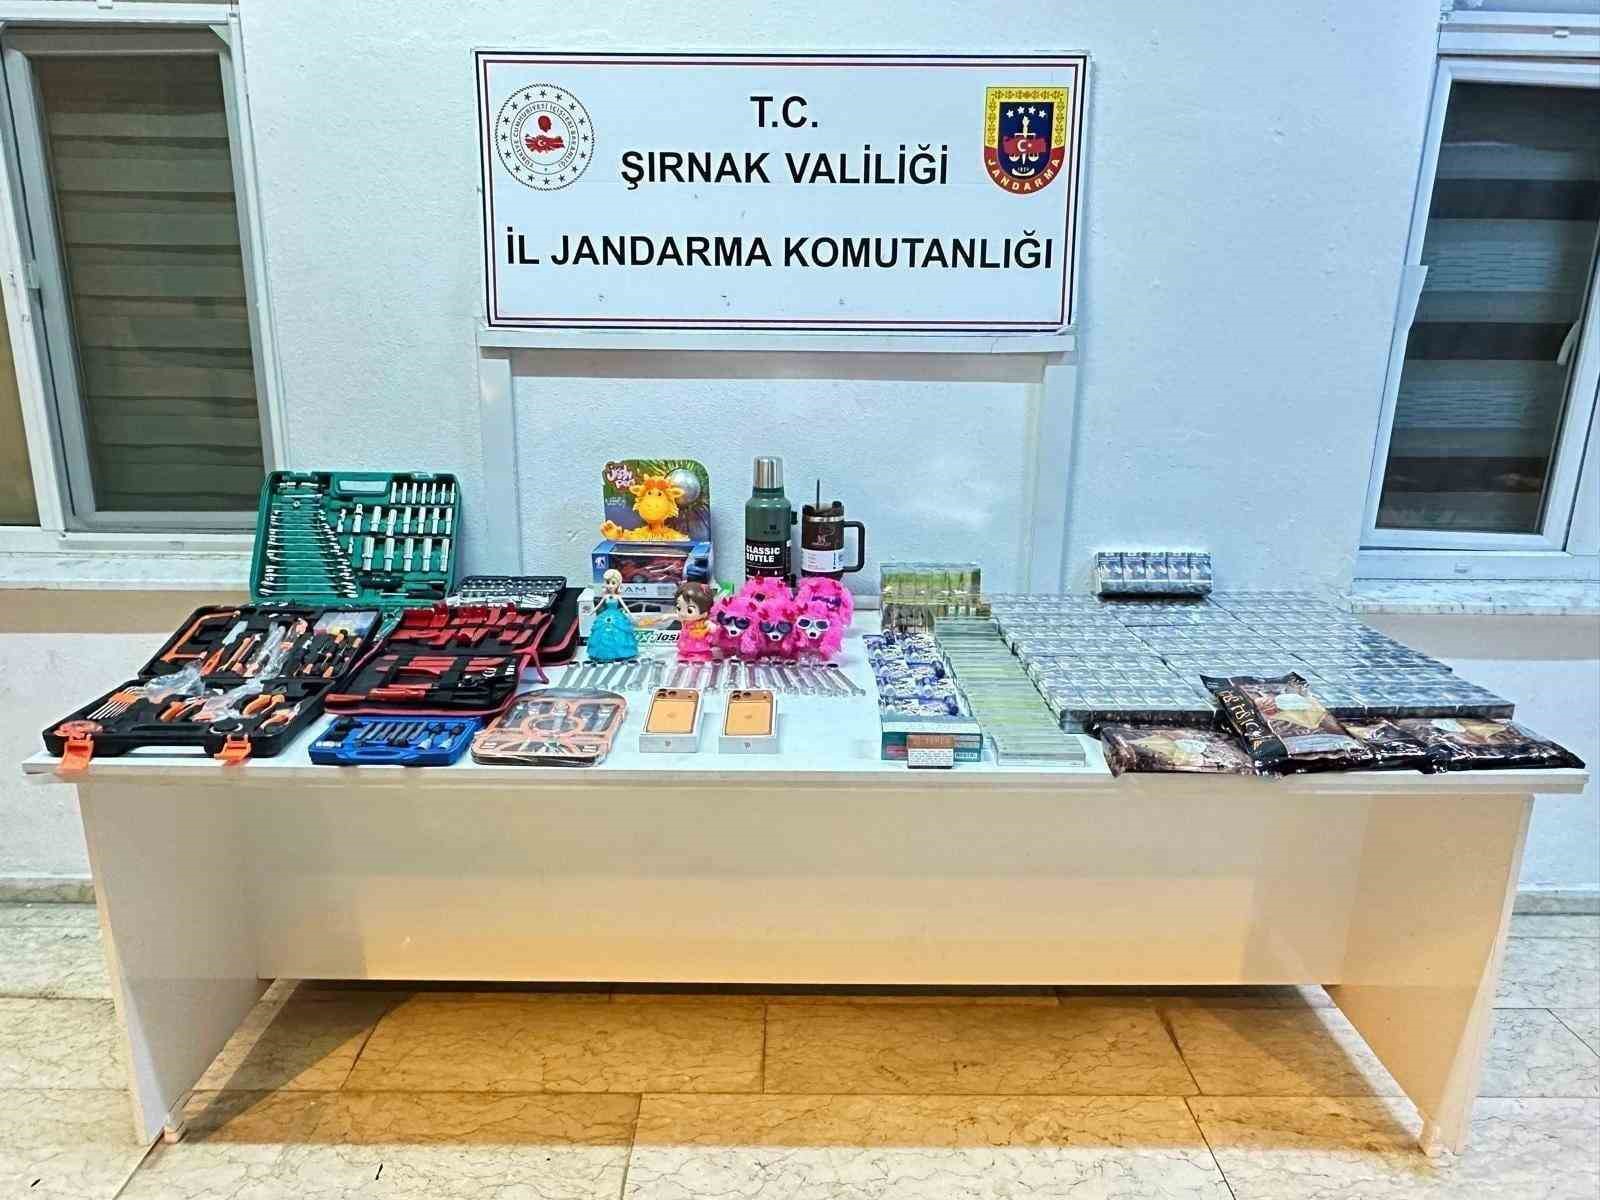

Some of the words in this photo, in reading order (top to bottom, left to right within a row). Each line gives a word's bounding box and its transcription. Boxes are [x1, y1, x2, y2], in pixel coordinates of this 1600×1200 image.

[750, 96, 818, 128] T.C.
[621, 151, 770, 190] ŞIRNAK
[785, 144, 947, 184] VALİLİĞİ
[987, 159, 1060, 191] JANDARMA
[507, 226, 540, 265] İL
[551, 235, 772, 266] JANDARMA
[784, 230, 1053, 269] KOMUTANLIĞI
[746, 545, 780, 555] CLASSIC
